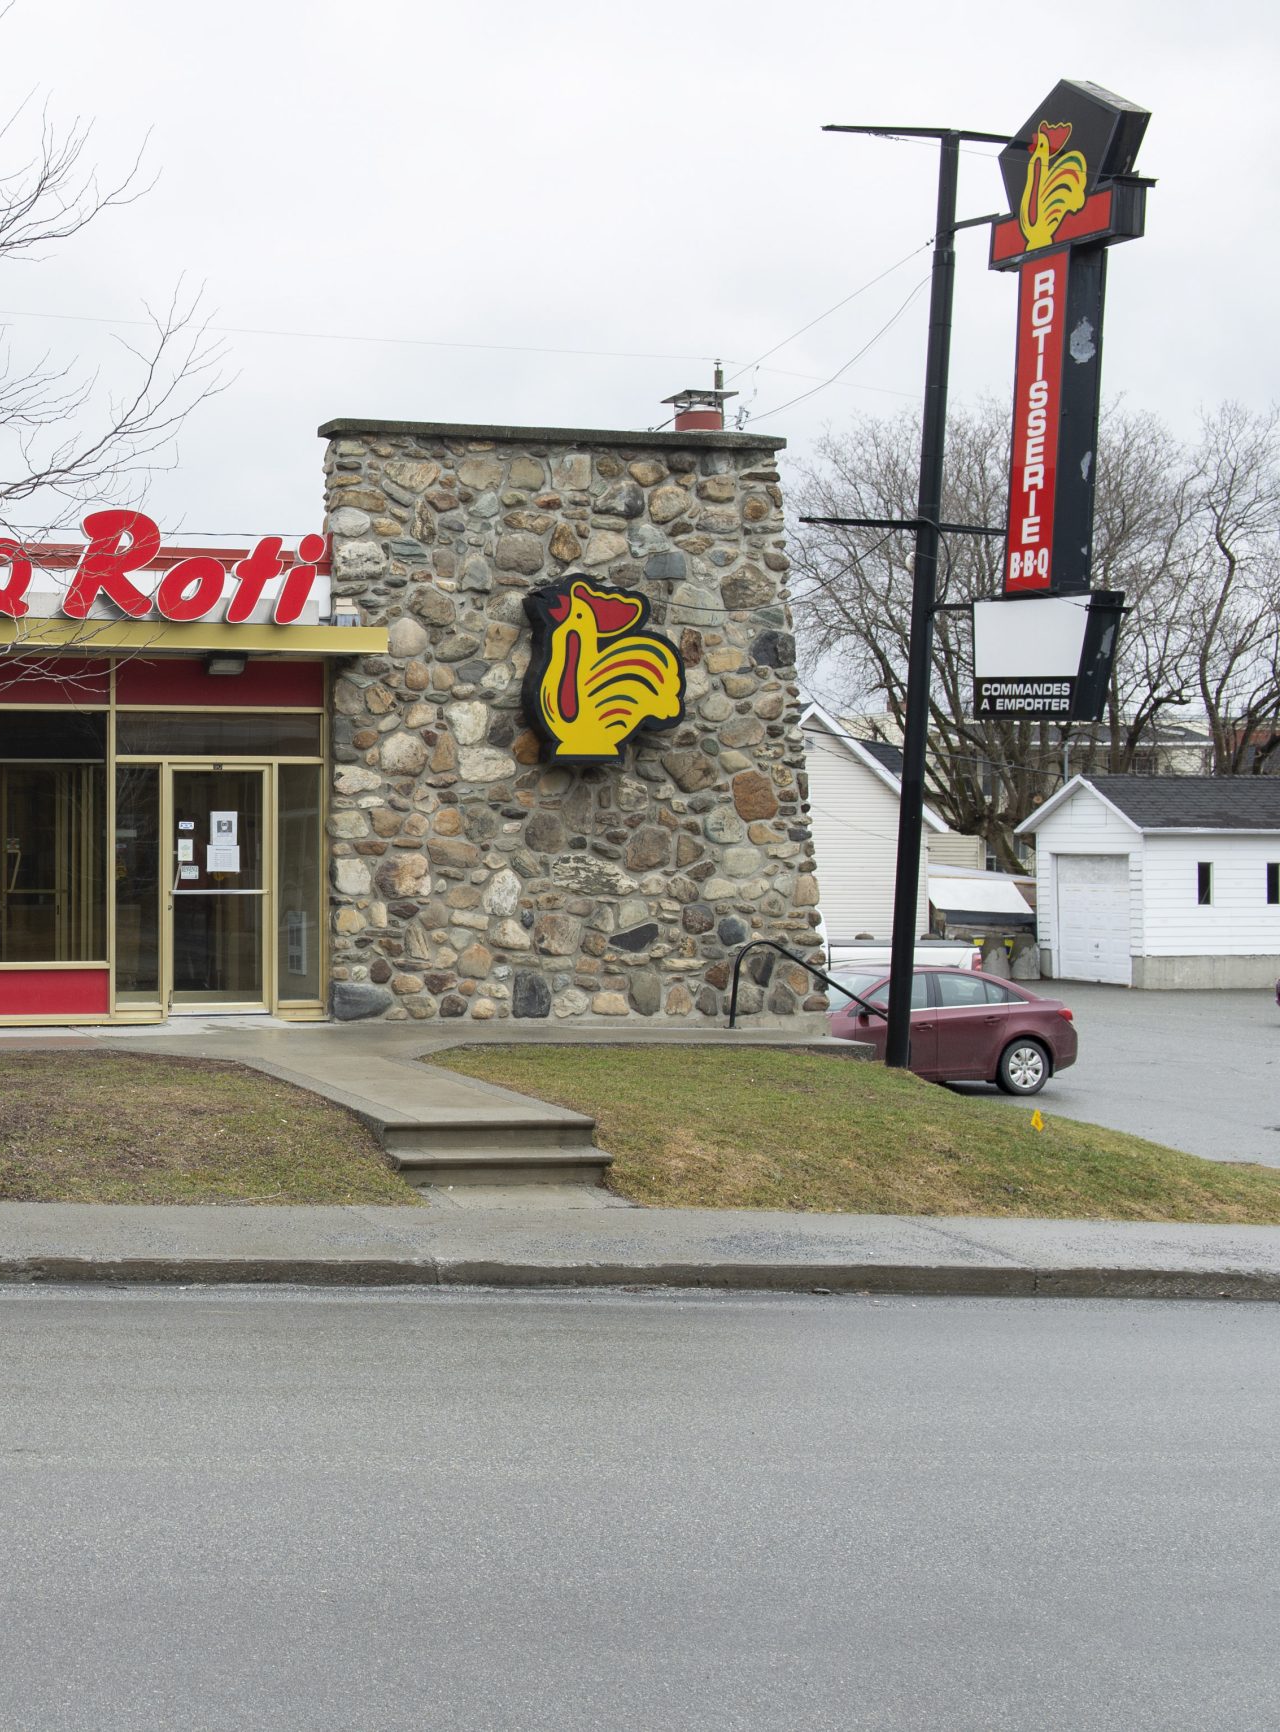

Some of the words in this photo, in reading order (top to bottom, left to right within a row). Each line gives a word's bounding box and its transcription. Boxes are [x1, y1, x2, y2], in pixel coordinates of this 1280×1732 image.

[1021, 269, 1056, 545] ROTISSERIE
[61, 508, 326, 626] Roti
[981, 683, 1071, 696] COMMANDES
[995, 698, 1070, 711] EMPORTER
